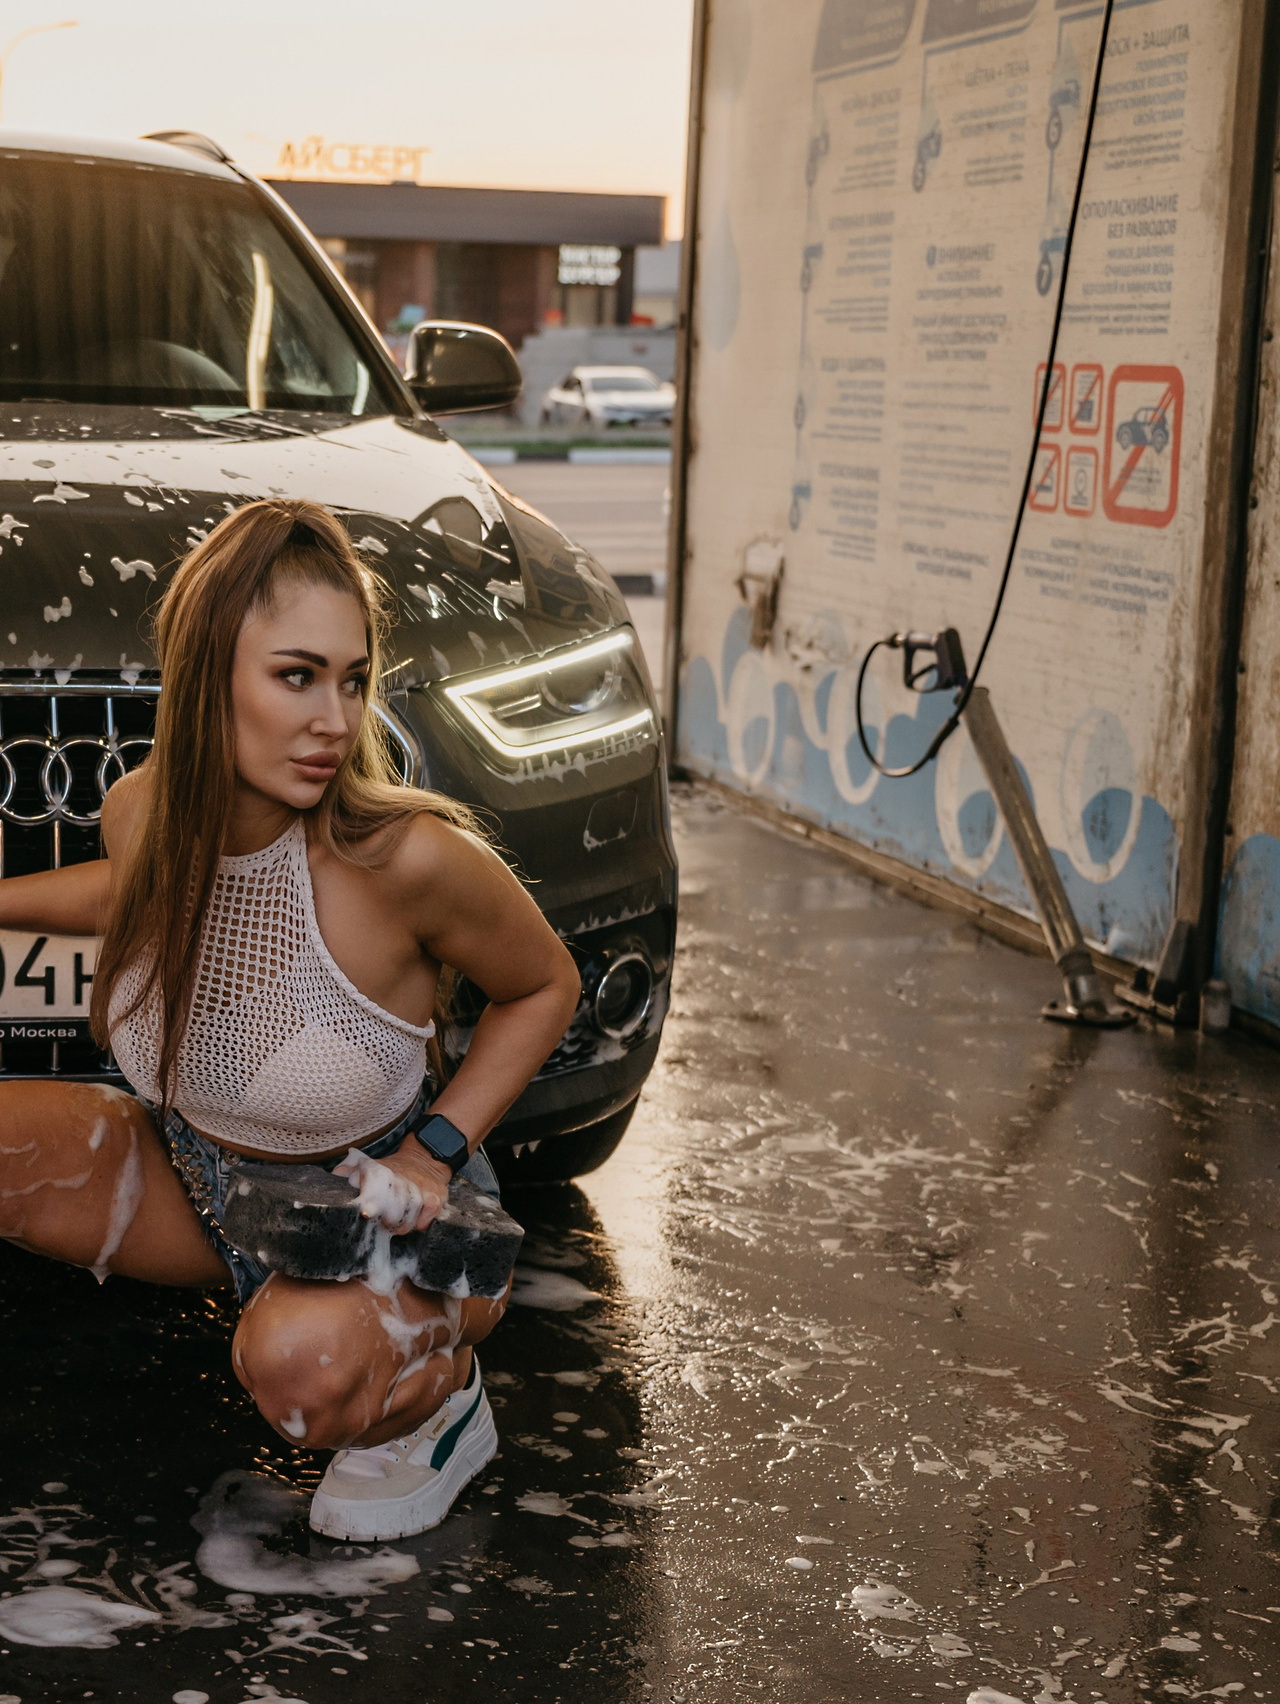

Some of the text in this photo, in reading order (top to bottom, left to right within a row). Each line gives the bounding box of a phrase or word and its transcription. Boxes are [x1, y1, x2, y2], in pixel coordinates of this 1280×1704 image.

[277, 134, 434, 178] АЙСБЕРГ
[1081, 193, 1178, 220] ОПОЛАСКИВАНИЕ
[11, 1027, 77, 1039] Москва
